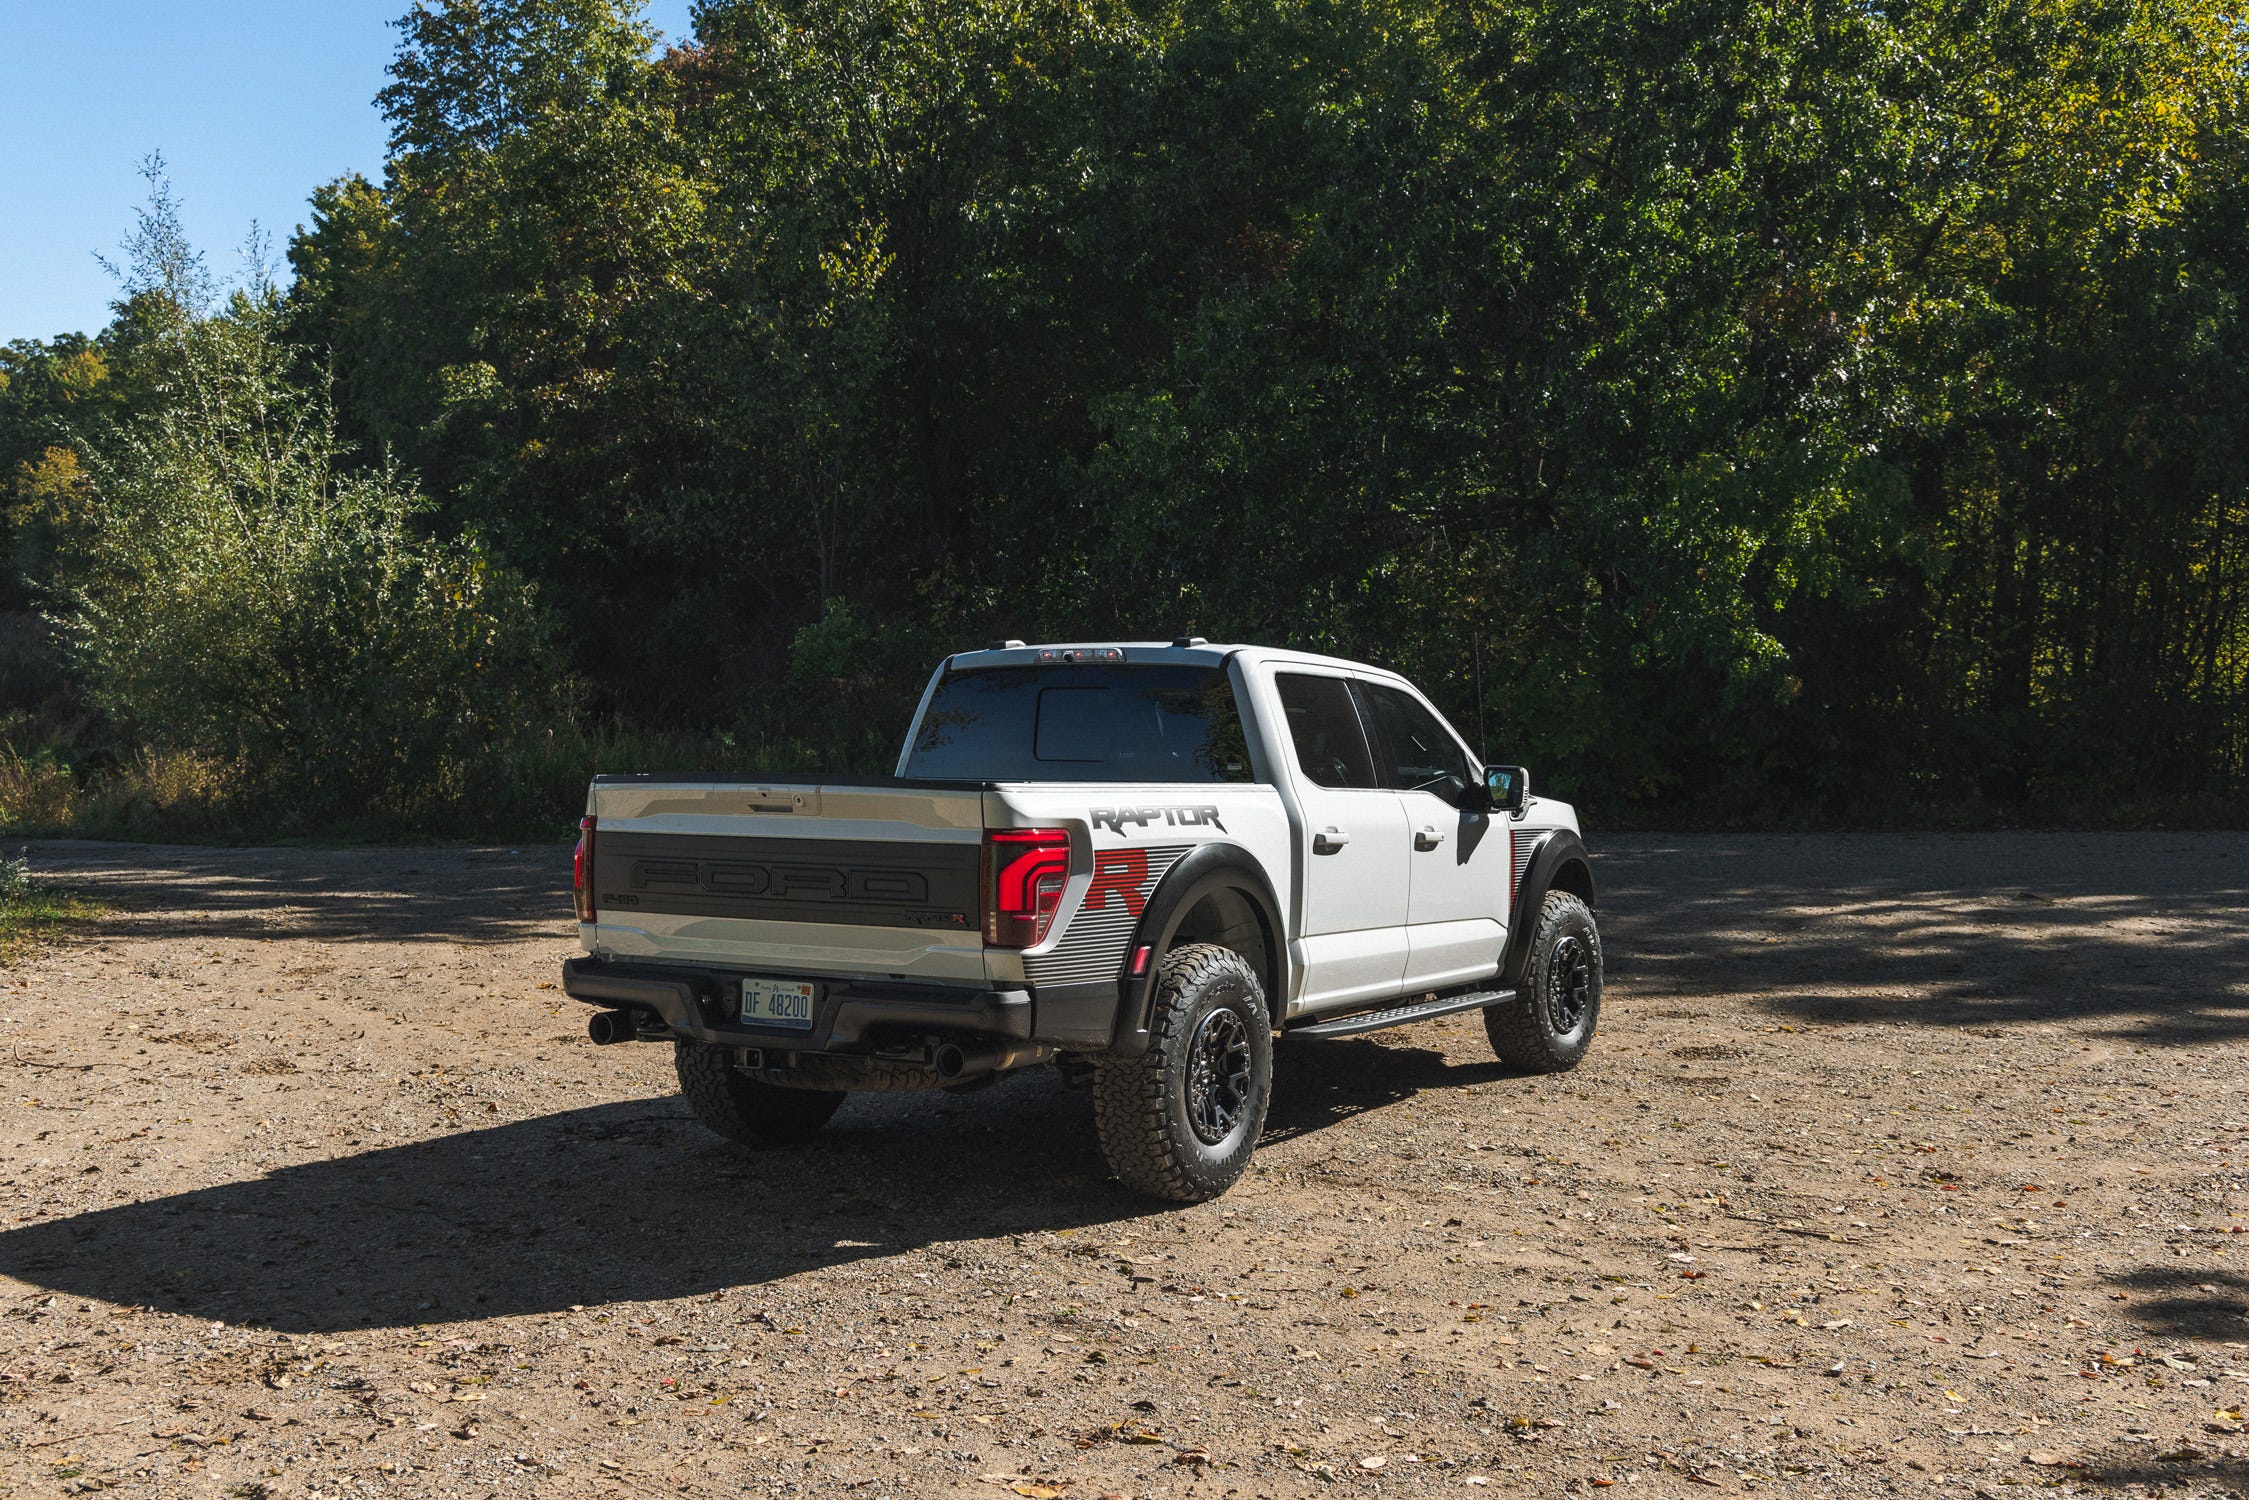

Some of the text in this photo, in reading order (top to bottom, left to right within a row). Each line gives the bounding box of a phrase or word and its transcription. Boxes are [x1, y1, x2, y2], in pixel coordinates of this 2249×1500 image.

[1088, 804, 1228, 838] RAPTOR
[630, 860, 928, 902] FORD
[1084, 849, 1149, 918] R
[745, 991, 808, 1018] DF 48200
